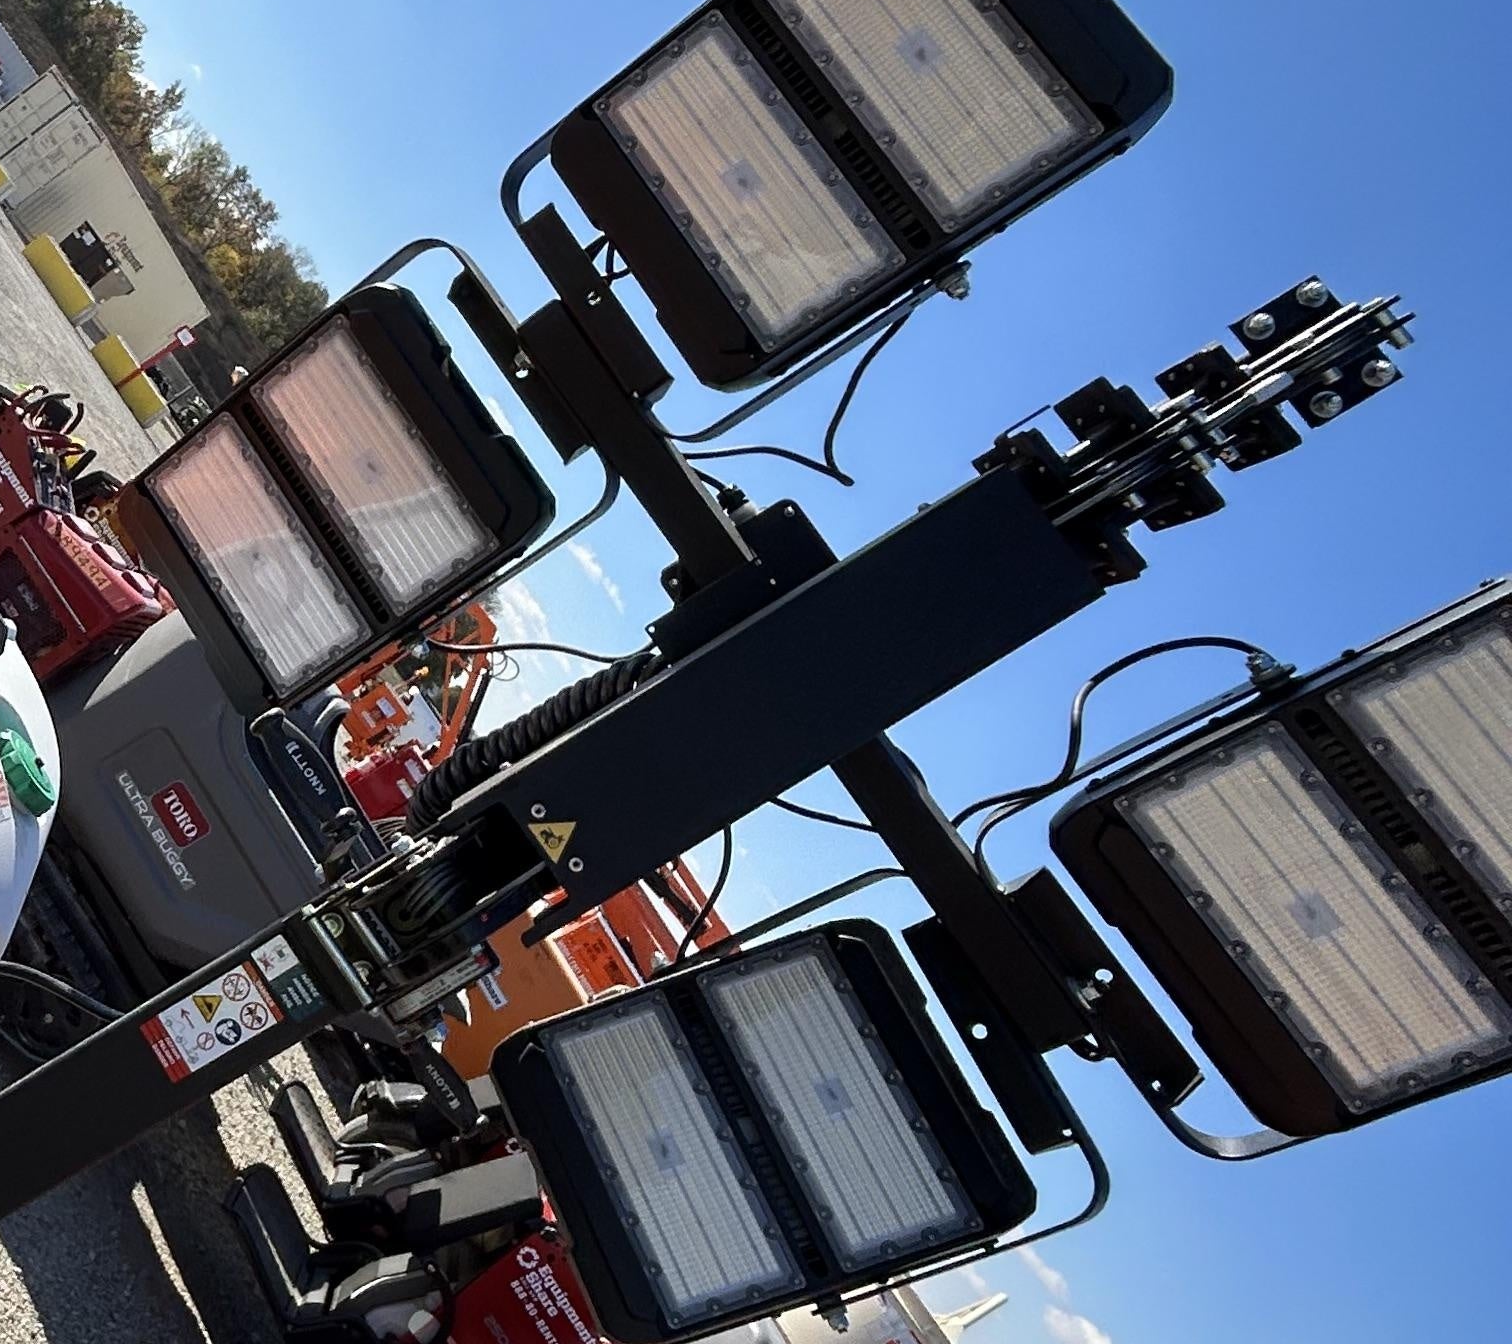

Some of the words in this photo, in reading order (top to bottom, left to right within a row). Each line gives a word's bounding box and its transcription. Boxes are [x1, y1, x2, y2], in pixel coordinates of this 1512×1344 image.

[295, 751, 328, 795] KNOTT
[118, 774, 157, 826] ULTRA
[151, 828, 197, 889] BUGGY
[163, 792, 199, 841] TORO
[527, 1271, 560, 1317] Share
